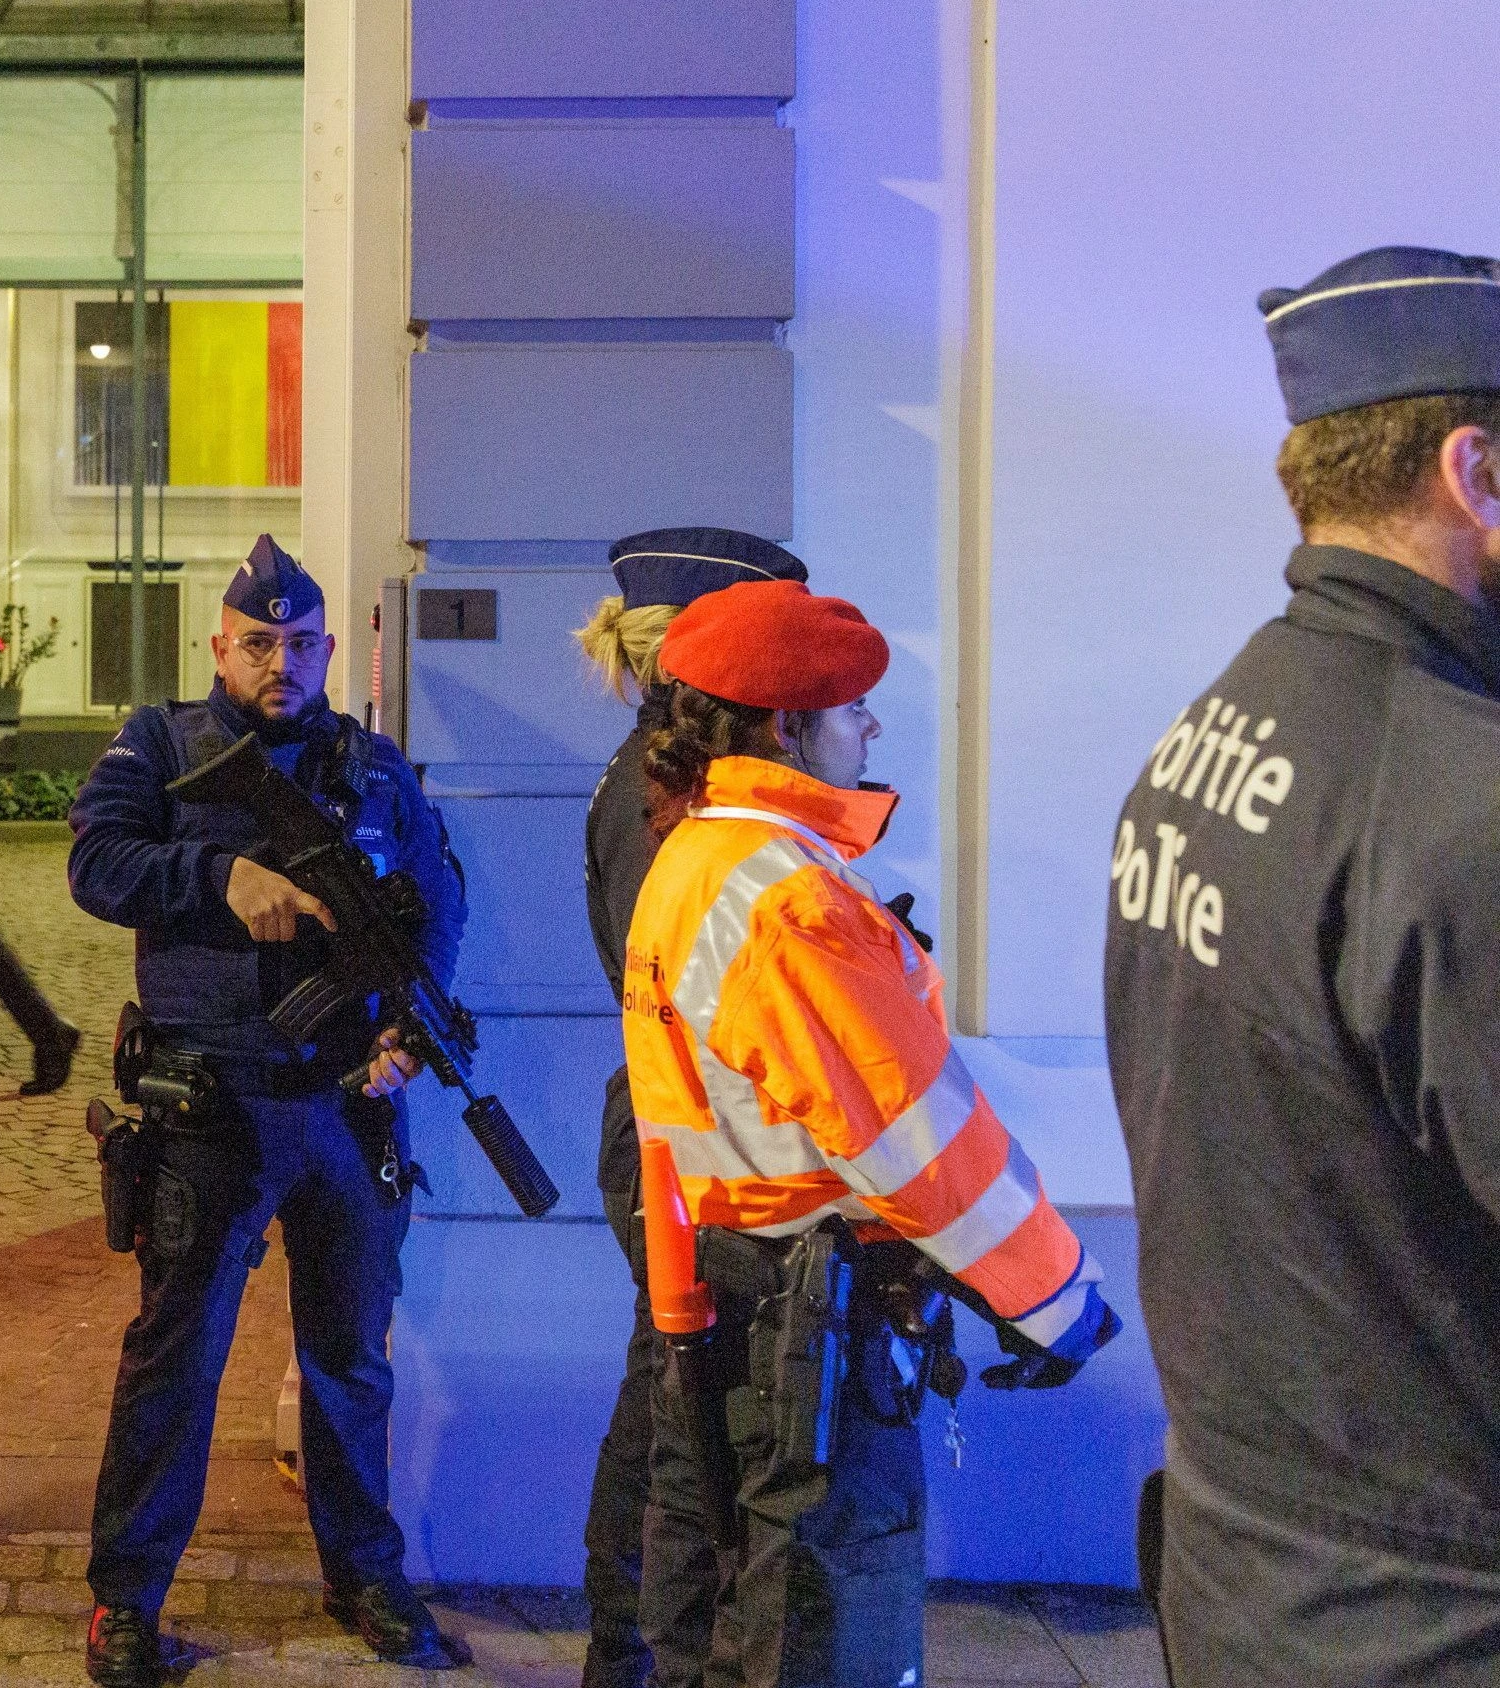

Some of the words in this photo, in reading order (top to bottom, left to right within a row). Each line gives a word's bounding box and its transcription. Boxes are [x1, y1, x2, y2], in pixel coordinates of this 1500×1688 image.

[450, 598, 465, 634] 1
[106, 746, 136, 757] olitie
[355, 826, 383, 837] olitie
